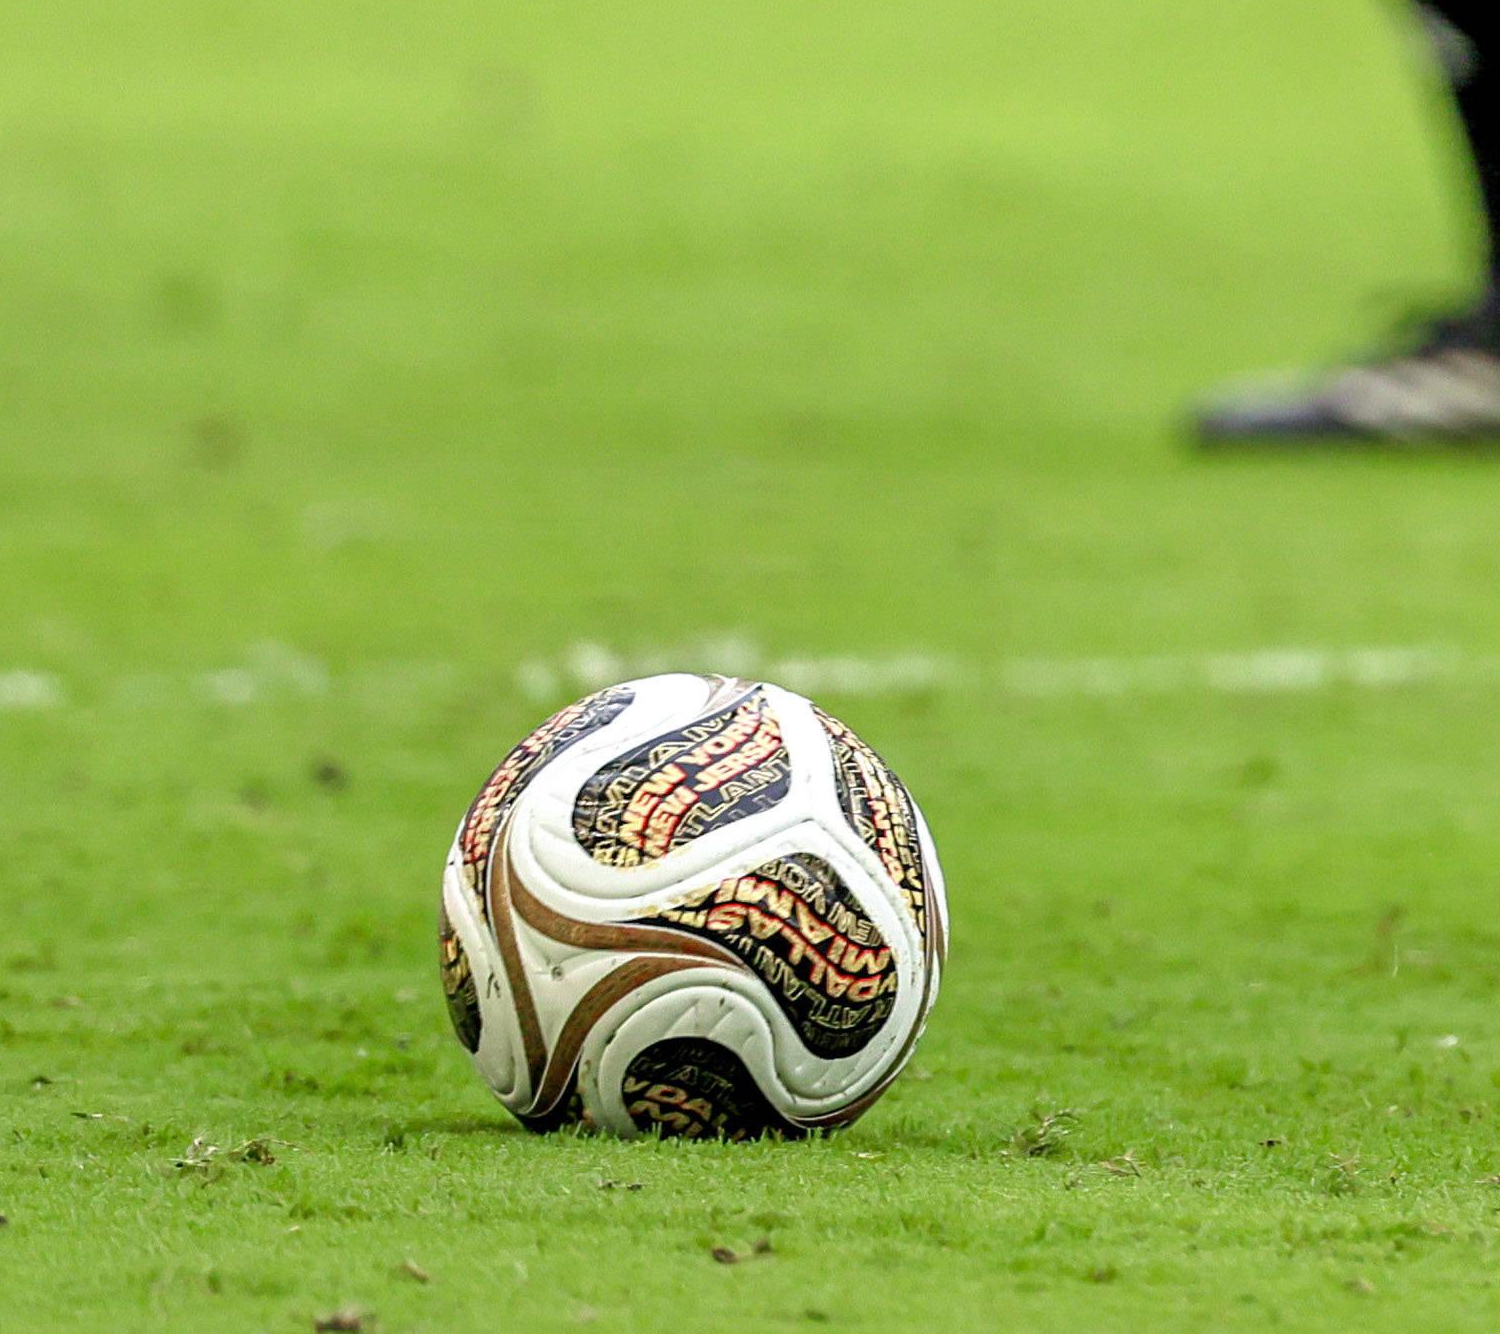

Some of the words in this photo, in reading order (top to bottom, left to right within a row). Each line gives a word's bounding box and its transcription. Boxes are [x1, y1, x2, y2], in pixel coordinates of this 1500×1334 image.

[619, 763, 688, 848] NEW
[673, 703, 761, 766] YORK
[714, 876, 892, 975] MIAMI
[754, 859, 826, 915] YOR
[706, 902, 882, 1003] DALLAS
[724, 932, 870, 1030] ATLAN
